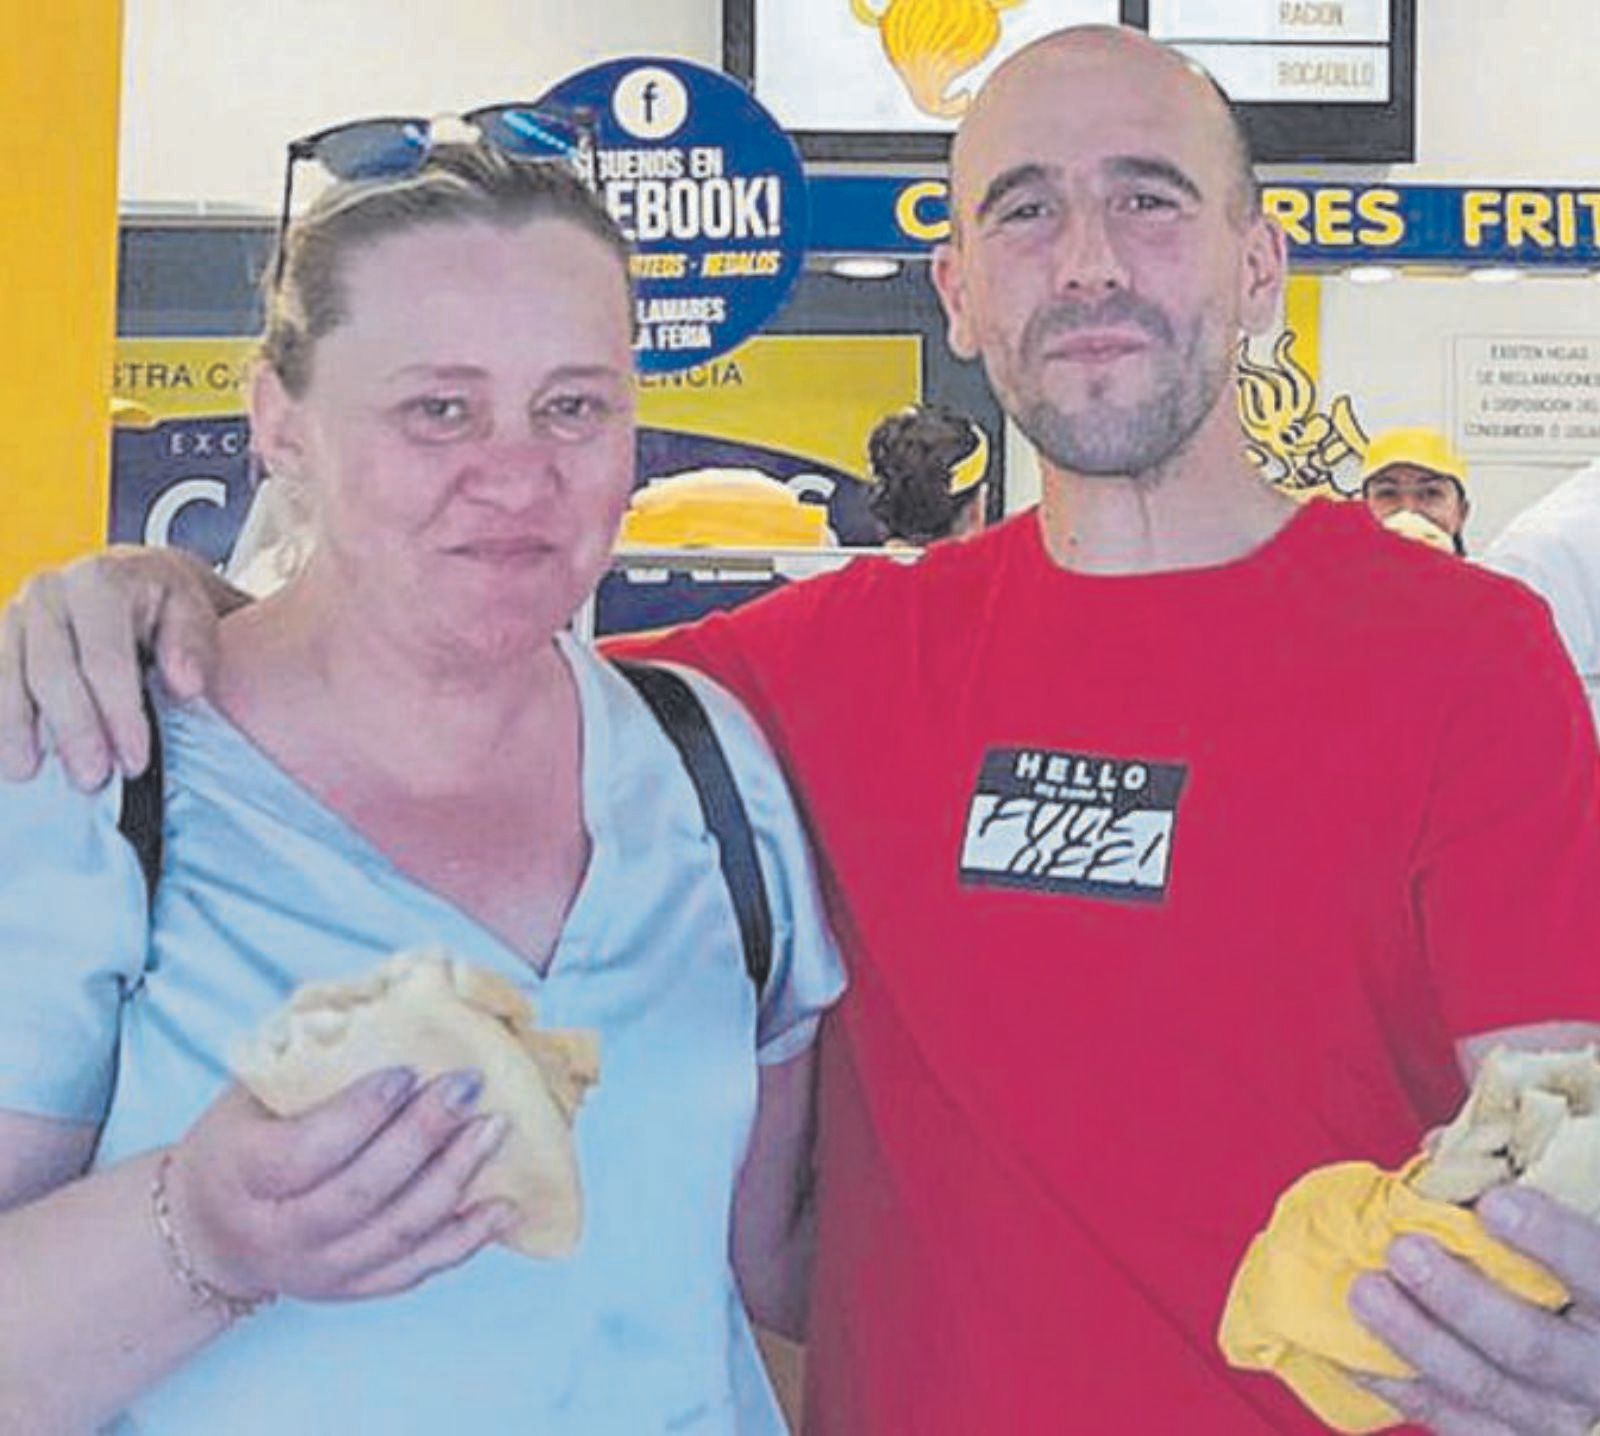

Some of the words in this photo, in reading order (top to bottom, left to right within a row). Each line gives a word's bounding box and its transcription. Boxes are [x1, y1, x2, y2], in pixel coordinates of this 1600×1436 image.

[690, 147, 724, 178] EN
[605, 176, 781, 240] EBOOK!
[1262, 189, 1404, 245] RES
[1463, 192, 1600, 247] FRIT
[636, 298, 726, 323] LAMARES
[172, 432, 239, 455] EXC
[1016, 753, 1147, 790] HELLO
